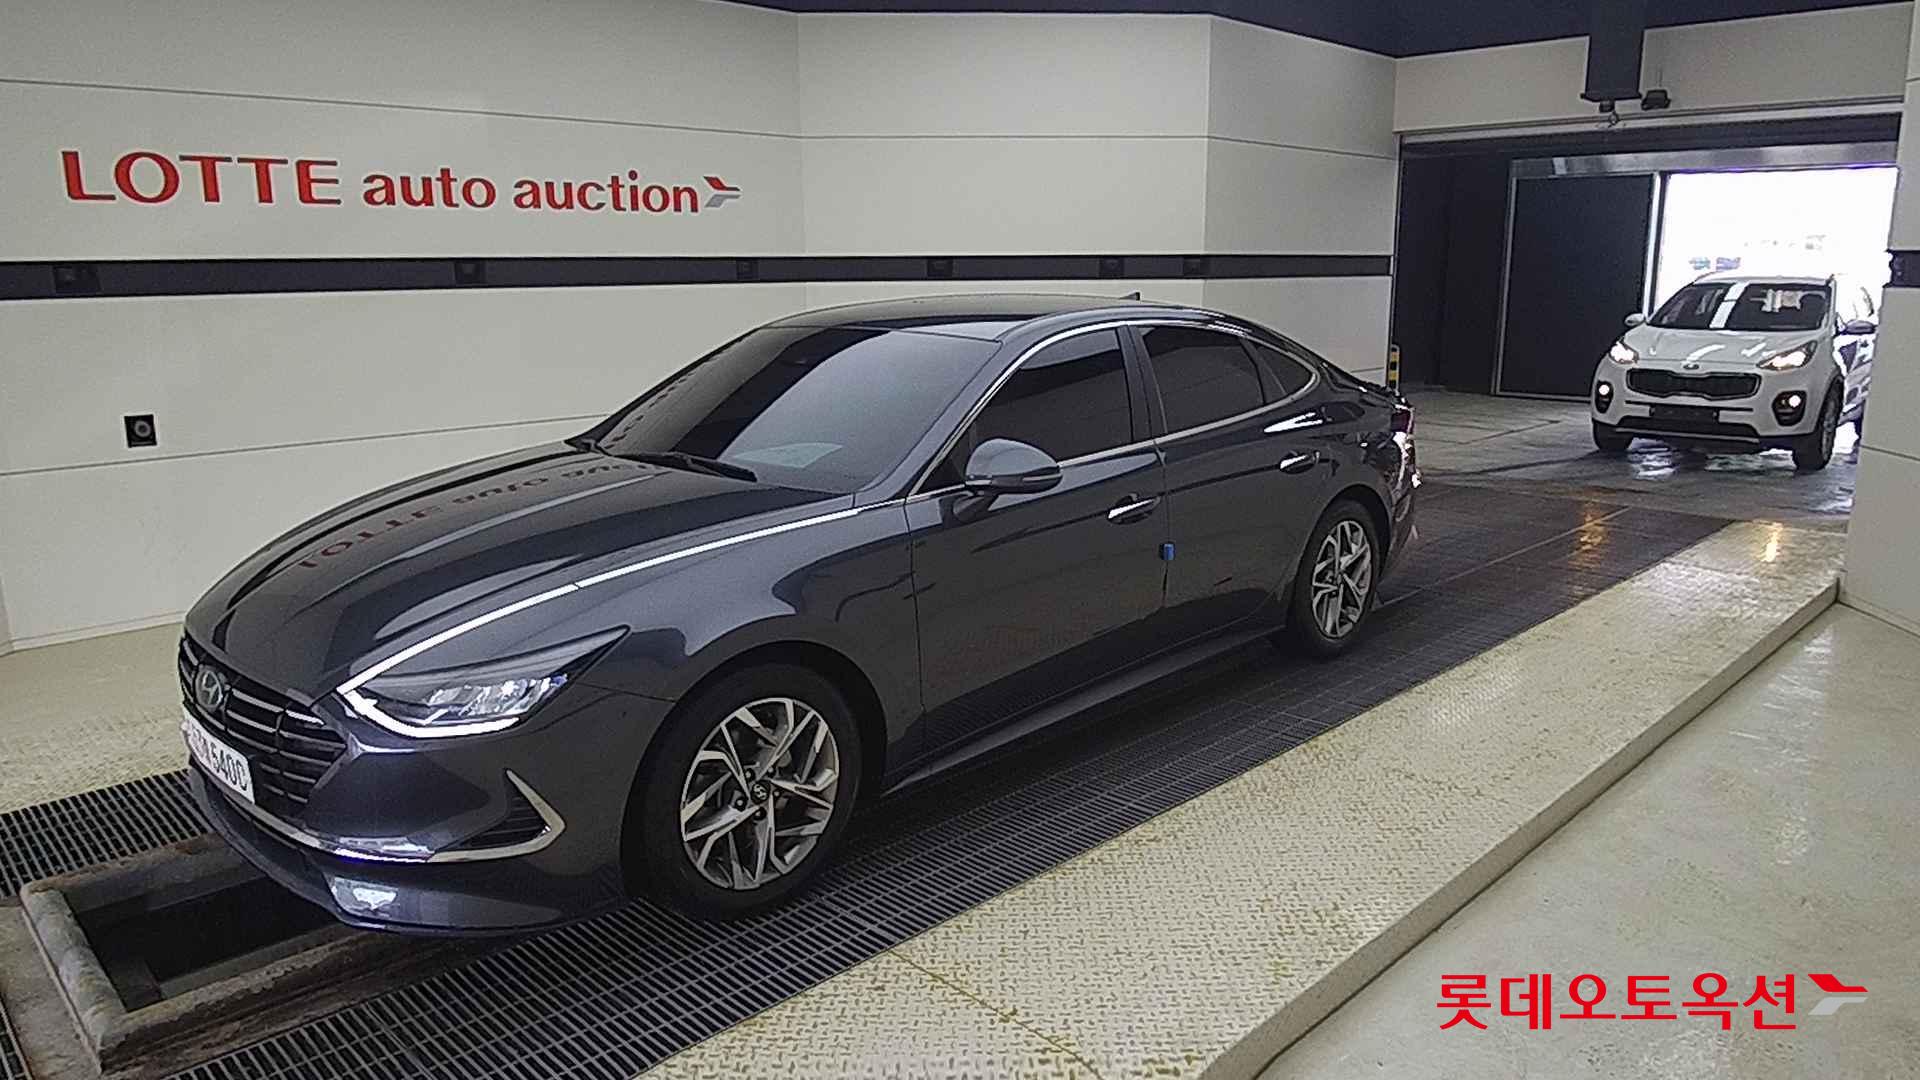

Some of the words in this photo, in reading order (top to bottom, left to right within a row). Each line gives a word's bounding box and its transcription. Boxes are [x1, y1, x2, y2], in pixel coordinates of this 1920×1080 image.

[62, 150, 341, 205] LOTTE
[362, 167, 497, 209] auto
[513, 170, 699, 214] auction
